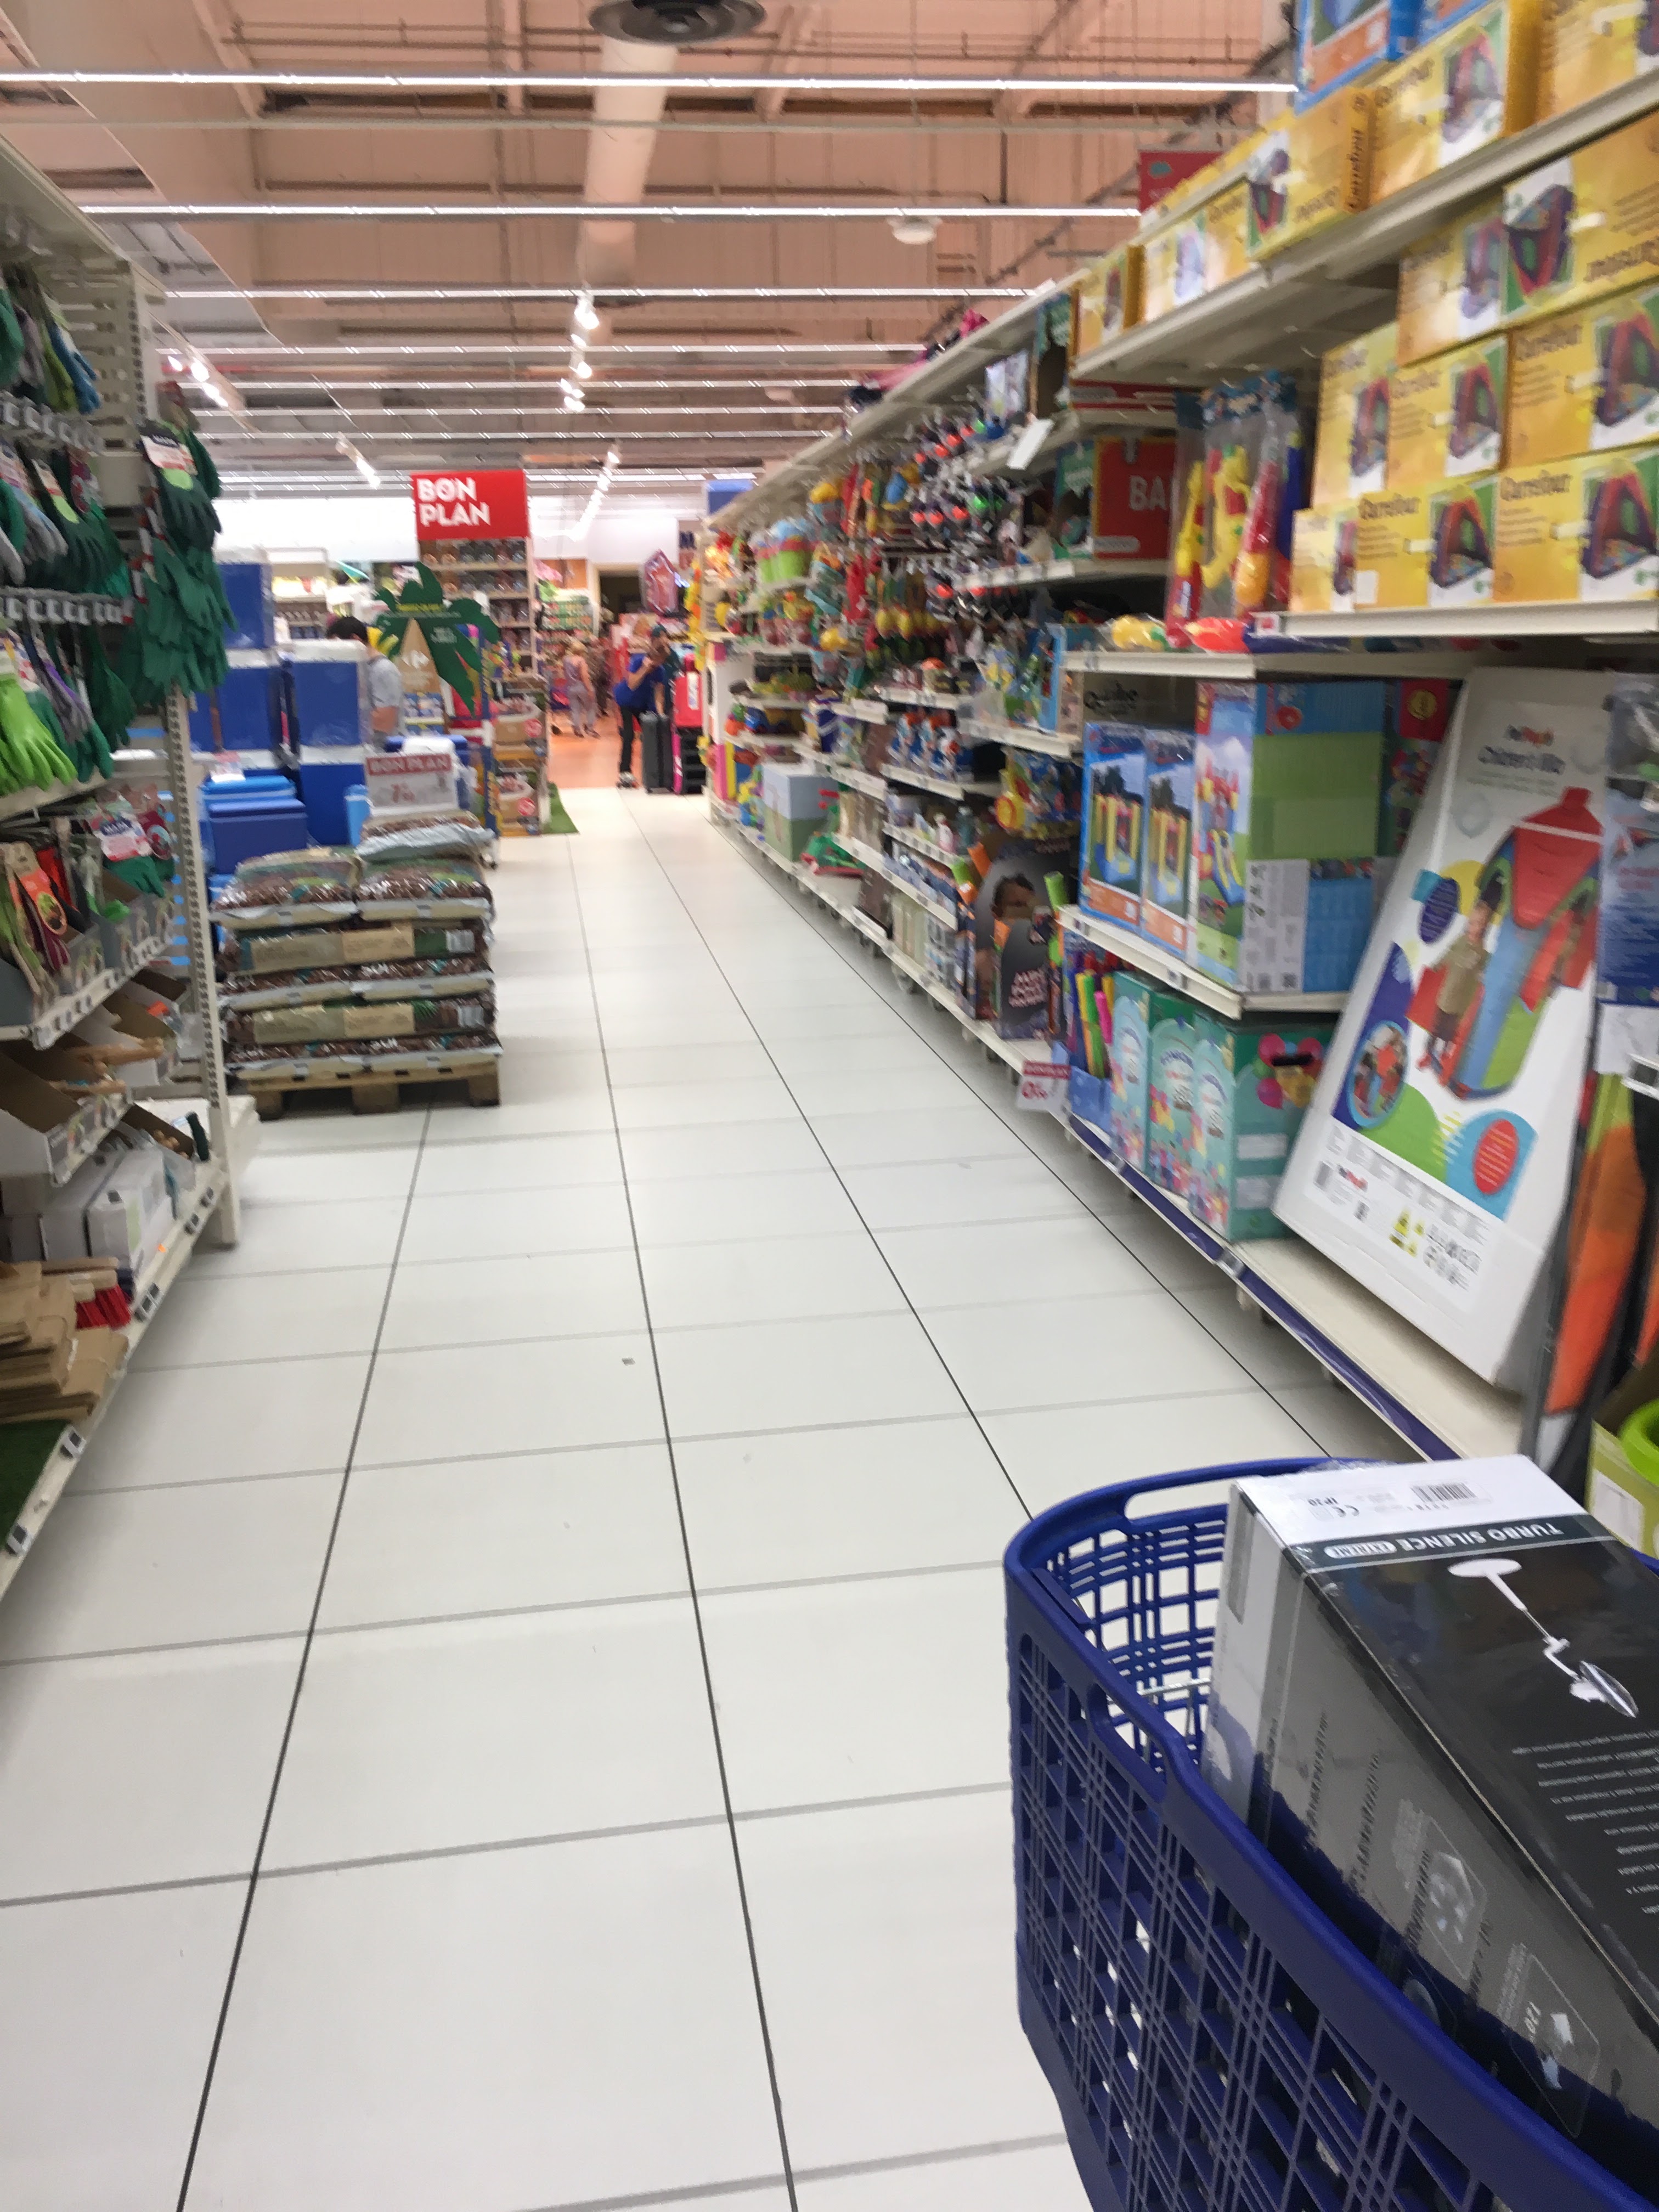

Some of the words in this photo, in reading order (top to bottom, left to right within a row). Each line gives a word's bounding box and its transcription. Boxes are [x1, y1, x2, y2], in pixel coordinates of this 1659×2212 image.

[416, 477, 477, 502] BON
[419, 501, 491, 527] PLAN
[1395, 1531, 1487, 1551] SILENCE
[1487, 1522, 1564, 1542] TURBO
